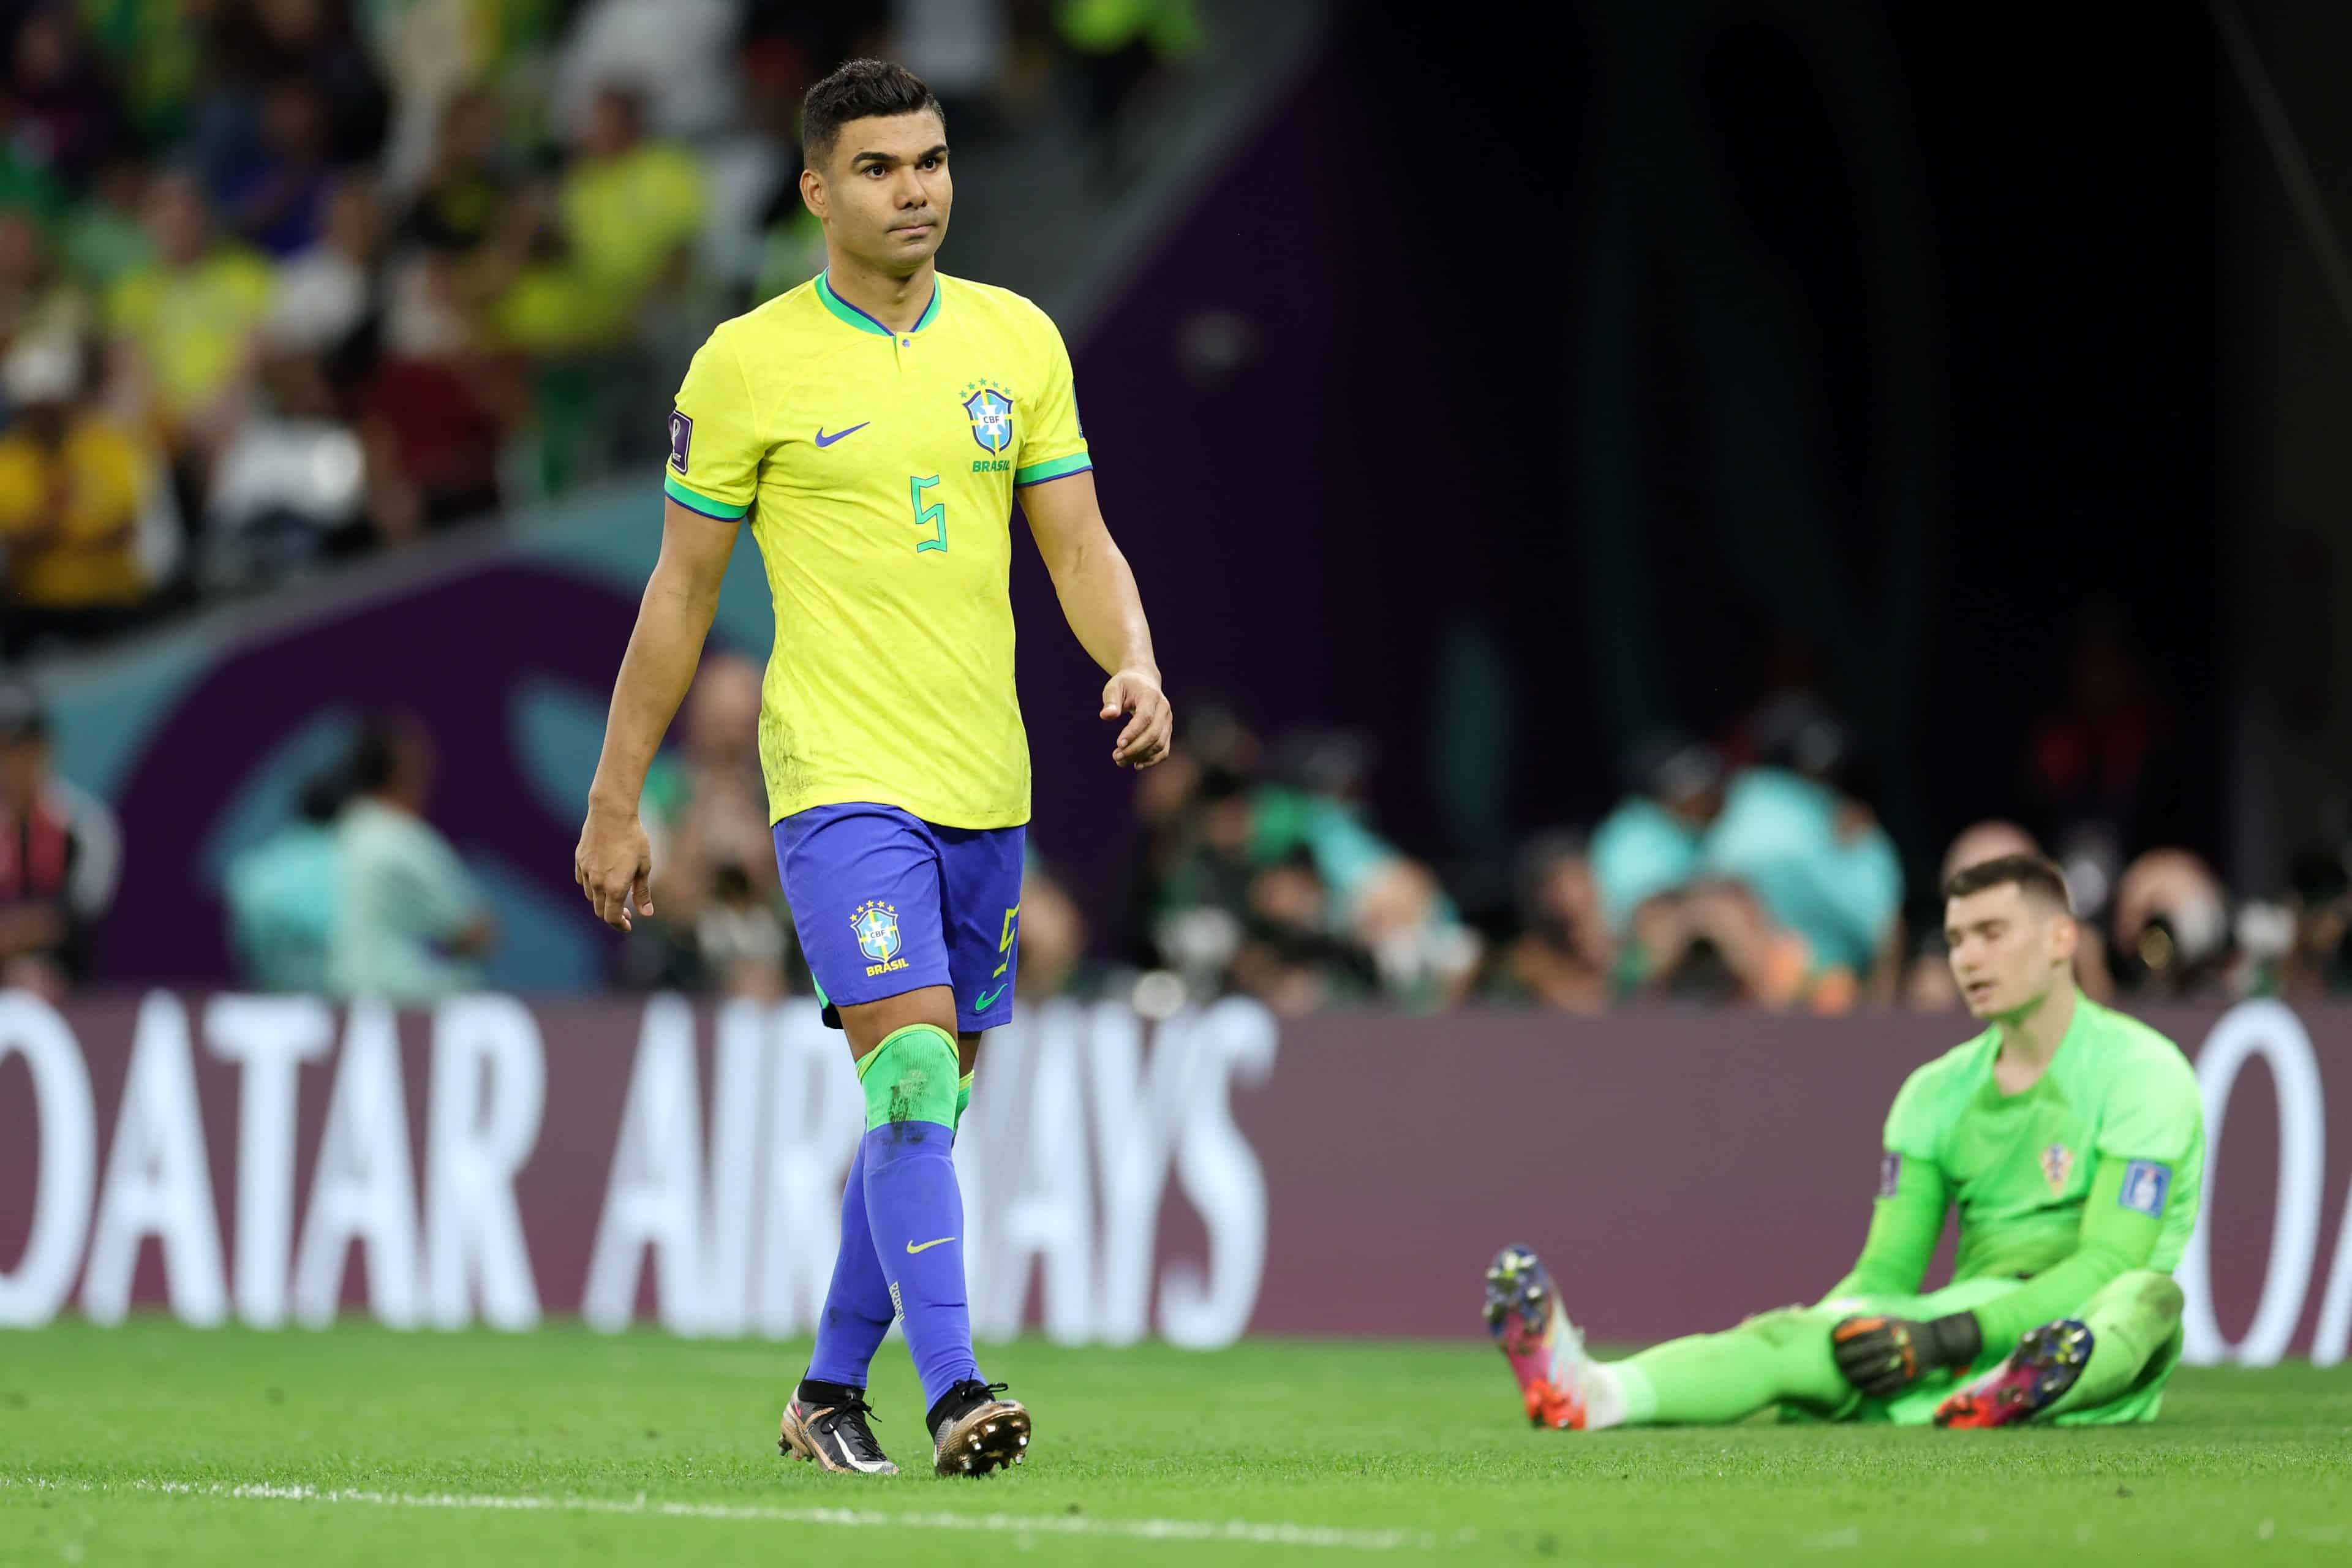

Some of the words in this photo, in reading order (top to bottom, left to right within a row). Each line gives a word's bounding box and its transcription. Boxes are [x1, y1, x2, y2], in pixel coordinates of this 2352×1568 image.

[973, 460, 1010, 473] BRASIL
[910, 474, 948, 553] 5
[870, 930, 886, 938] CBF
[865, 957, 910, 977] BRASIL
